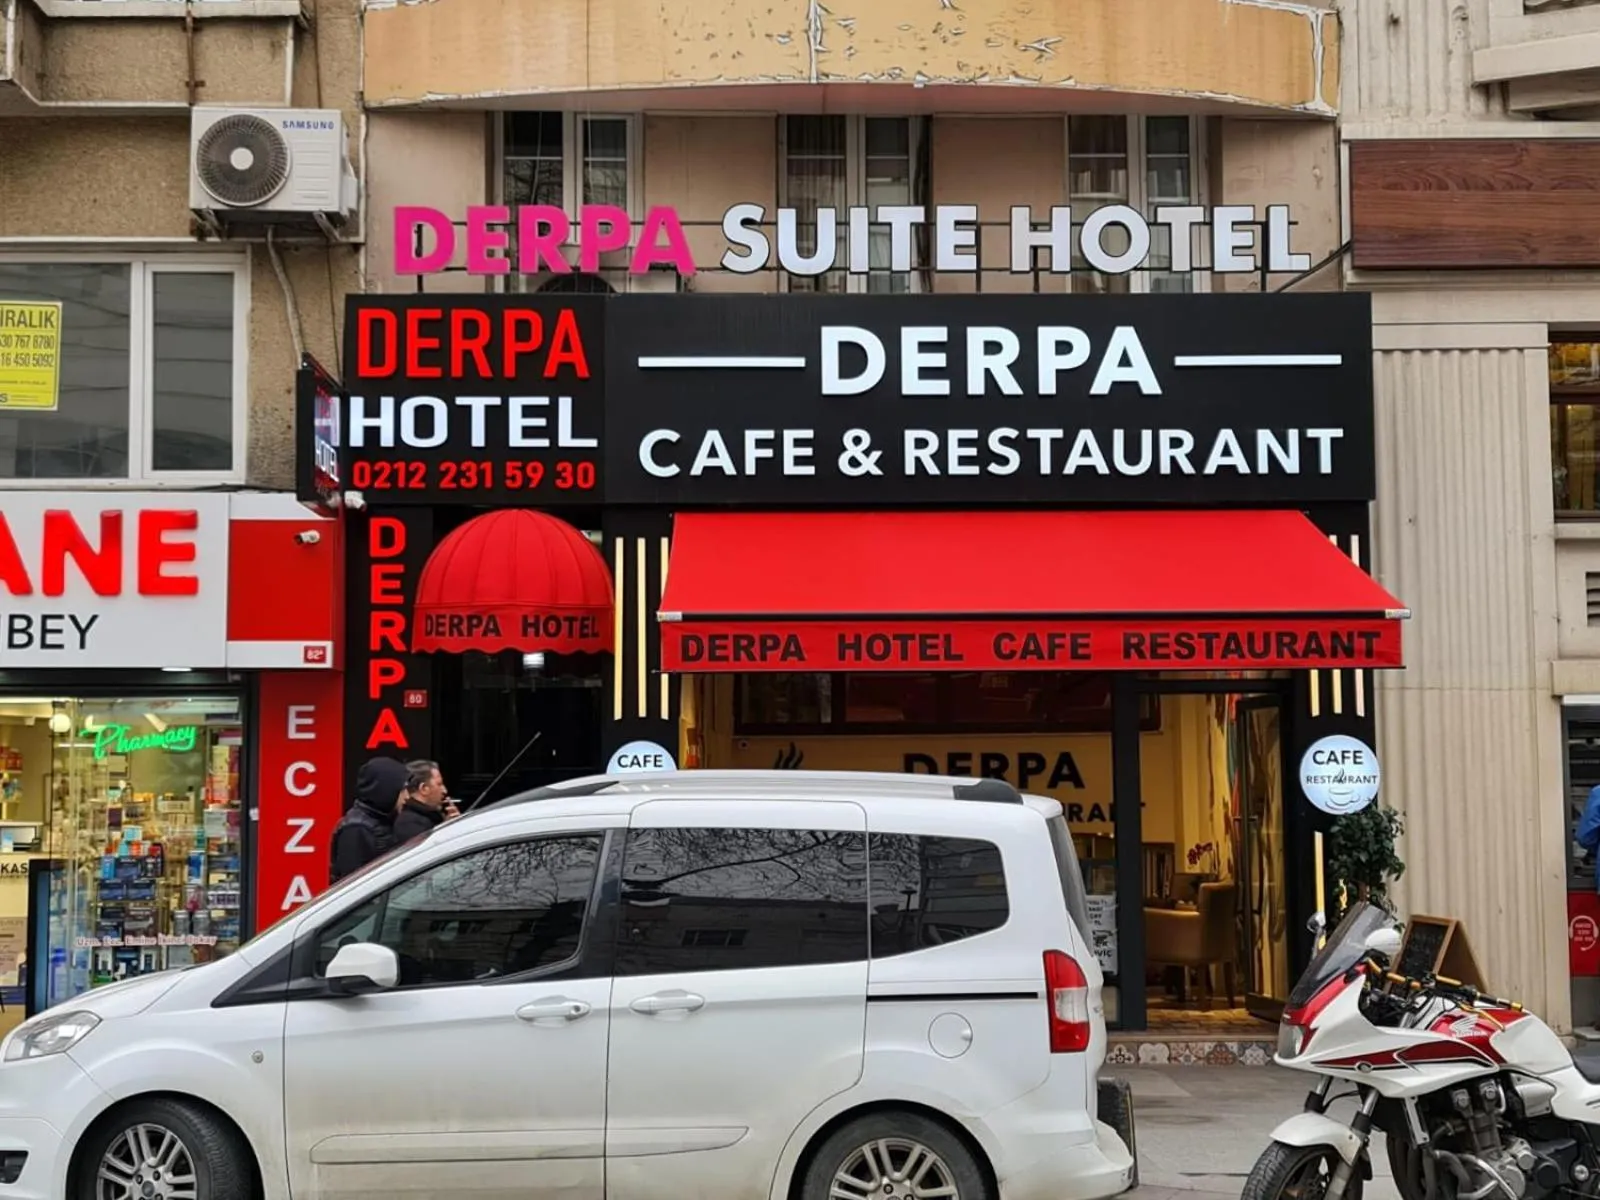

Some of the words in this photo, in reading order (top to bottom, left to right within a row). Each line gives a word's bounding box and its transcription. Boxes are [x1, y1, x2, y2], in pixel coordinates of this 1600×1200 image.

[282, 120, 335, 130] SAMSUNG
[393, 205, 696, 275] DERPA
[721, 204, 978, 275] SUITE
[1010, 204, 1311, 274] HOTEL
[358, 309, 590, 378] DERPA
[820, 326, 1163, 396] DERPA
[349, 396, 598, 448] HOTEL
[638, 428, 816, 478] CAFE
[837, 428, 884, 477] &
[903, 427, 1345, 477] RESTAURANT
[353, 461, 426, 488] 0212
[440, 461, 493, 488] 231
[505, 461, 544, 488] 59
[556, 461, 595, 488] 30
[366, 516, 408, 748] DERPA
[424, 613, 502, 638] DERPA
[521, 613, 600, 640] HOTEL
[680, 634, 806, 663] DERPA
[837, 633, 964, 662] HOTEL
[992, 632, 1092, 662] CAFE
[1122, 630, 1382, 661] RESTAURANT
[79, 722, 197, 761] Pharmacy
[1312, 750, 1364, 766] CAFE
[617, 754, 664, 769] CAFE
[1306, 775, 1377, 785] RESTAURANT
